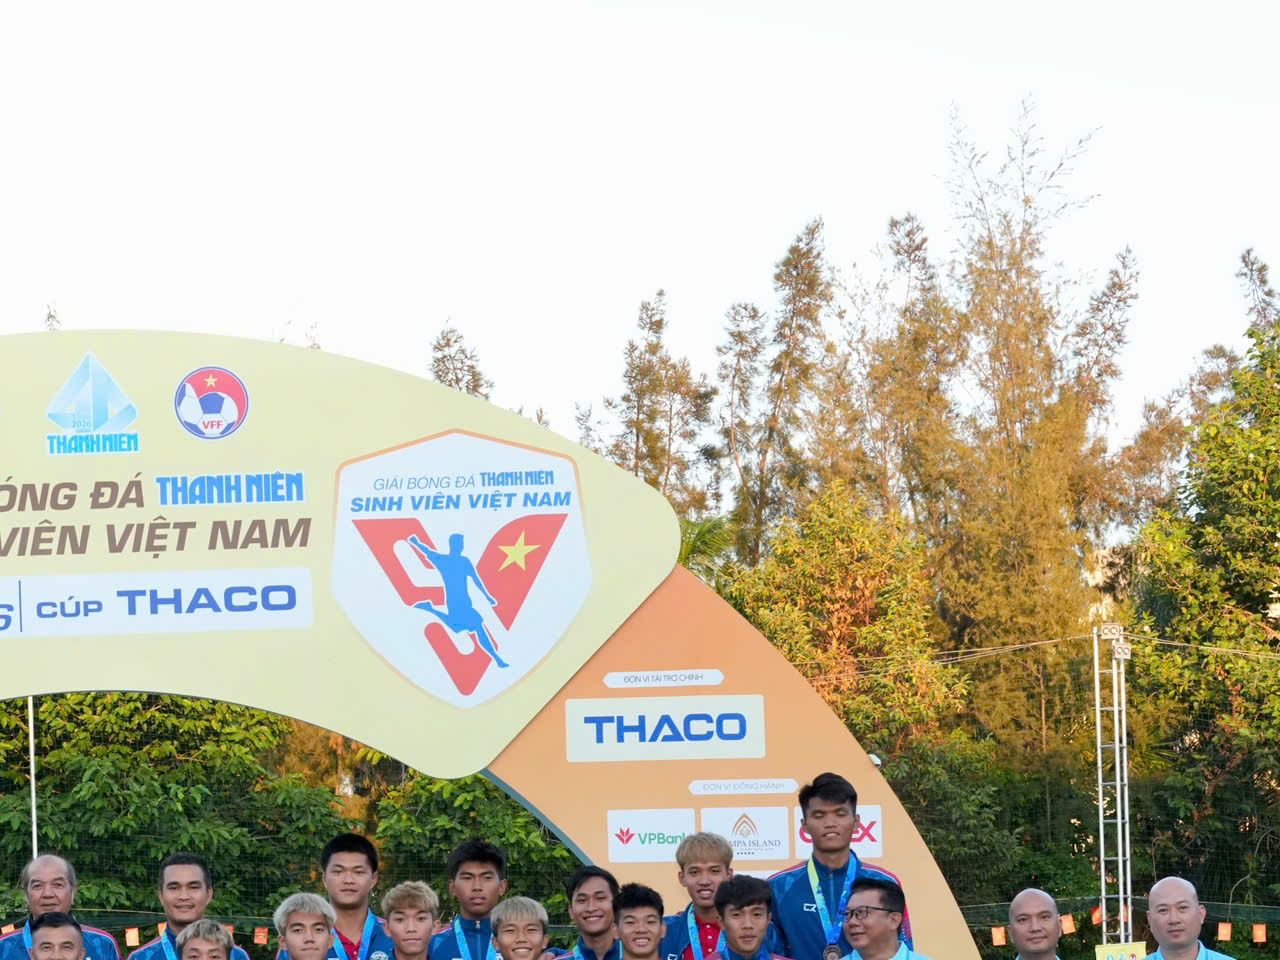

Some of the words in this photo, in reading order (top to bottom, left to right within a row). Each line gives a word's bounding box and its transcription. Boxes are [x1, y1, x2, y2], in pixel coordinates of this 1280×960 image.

[202, 420, 223, 429] VFF
[89, 472, 144, 509] ĐÁ
[156, 474, 242, 505] THANH
[245, 470, 304, 502] NIÊN
[454, 473, 476, 488] ĐÁ
[480, 471, 523, 487] THANH
[350, 496, 403, 512] SINH
[411, 492, 461, 510] VIÊN
[468, 490, 518, 511] VIỆT
[523, 491, 572, 508] NAM
[106, 515, 197, 559] VIỆT
[208, 518, 312, 550] NAM
[36, 596, 103, 618] CÚP
[117, 585, 296, 616] THACO
[584, 712, 746, 744] THACO
[638, 832, 686, 845] VPBan
[748, 839, 781, 847] ISLAND
